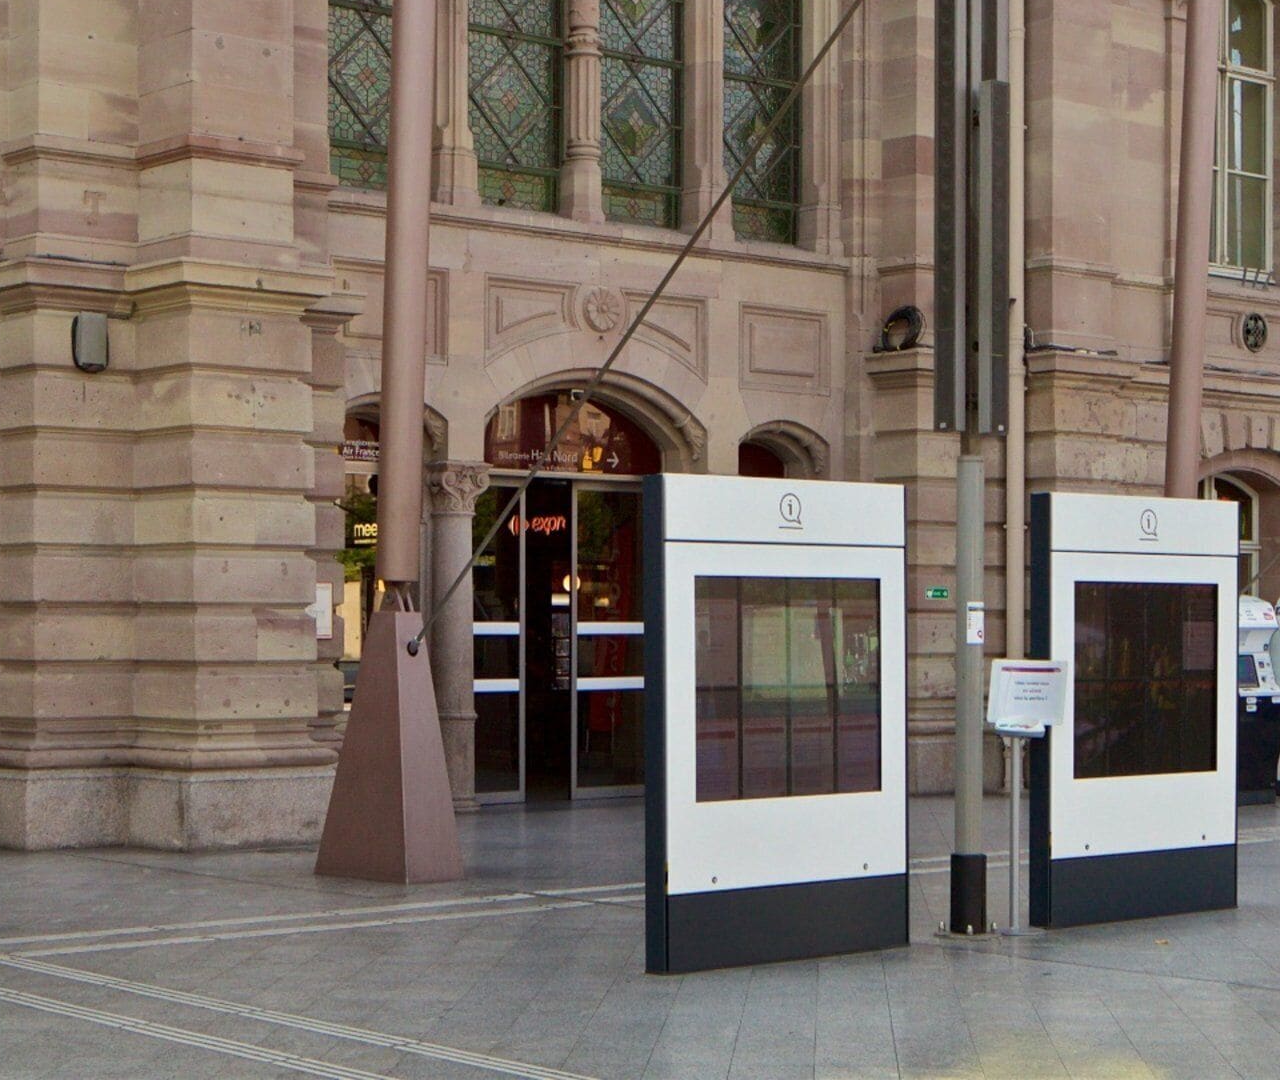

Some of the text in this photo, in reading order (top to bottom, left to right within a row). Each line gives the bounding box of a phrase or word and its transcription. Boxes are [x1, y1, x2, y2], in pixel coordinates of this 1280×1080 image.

[342, 447, 353, 455] Air
[553, 450, 578, 463] Nord
[353, 523, 378, 537] mee
